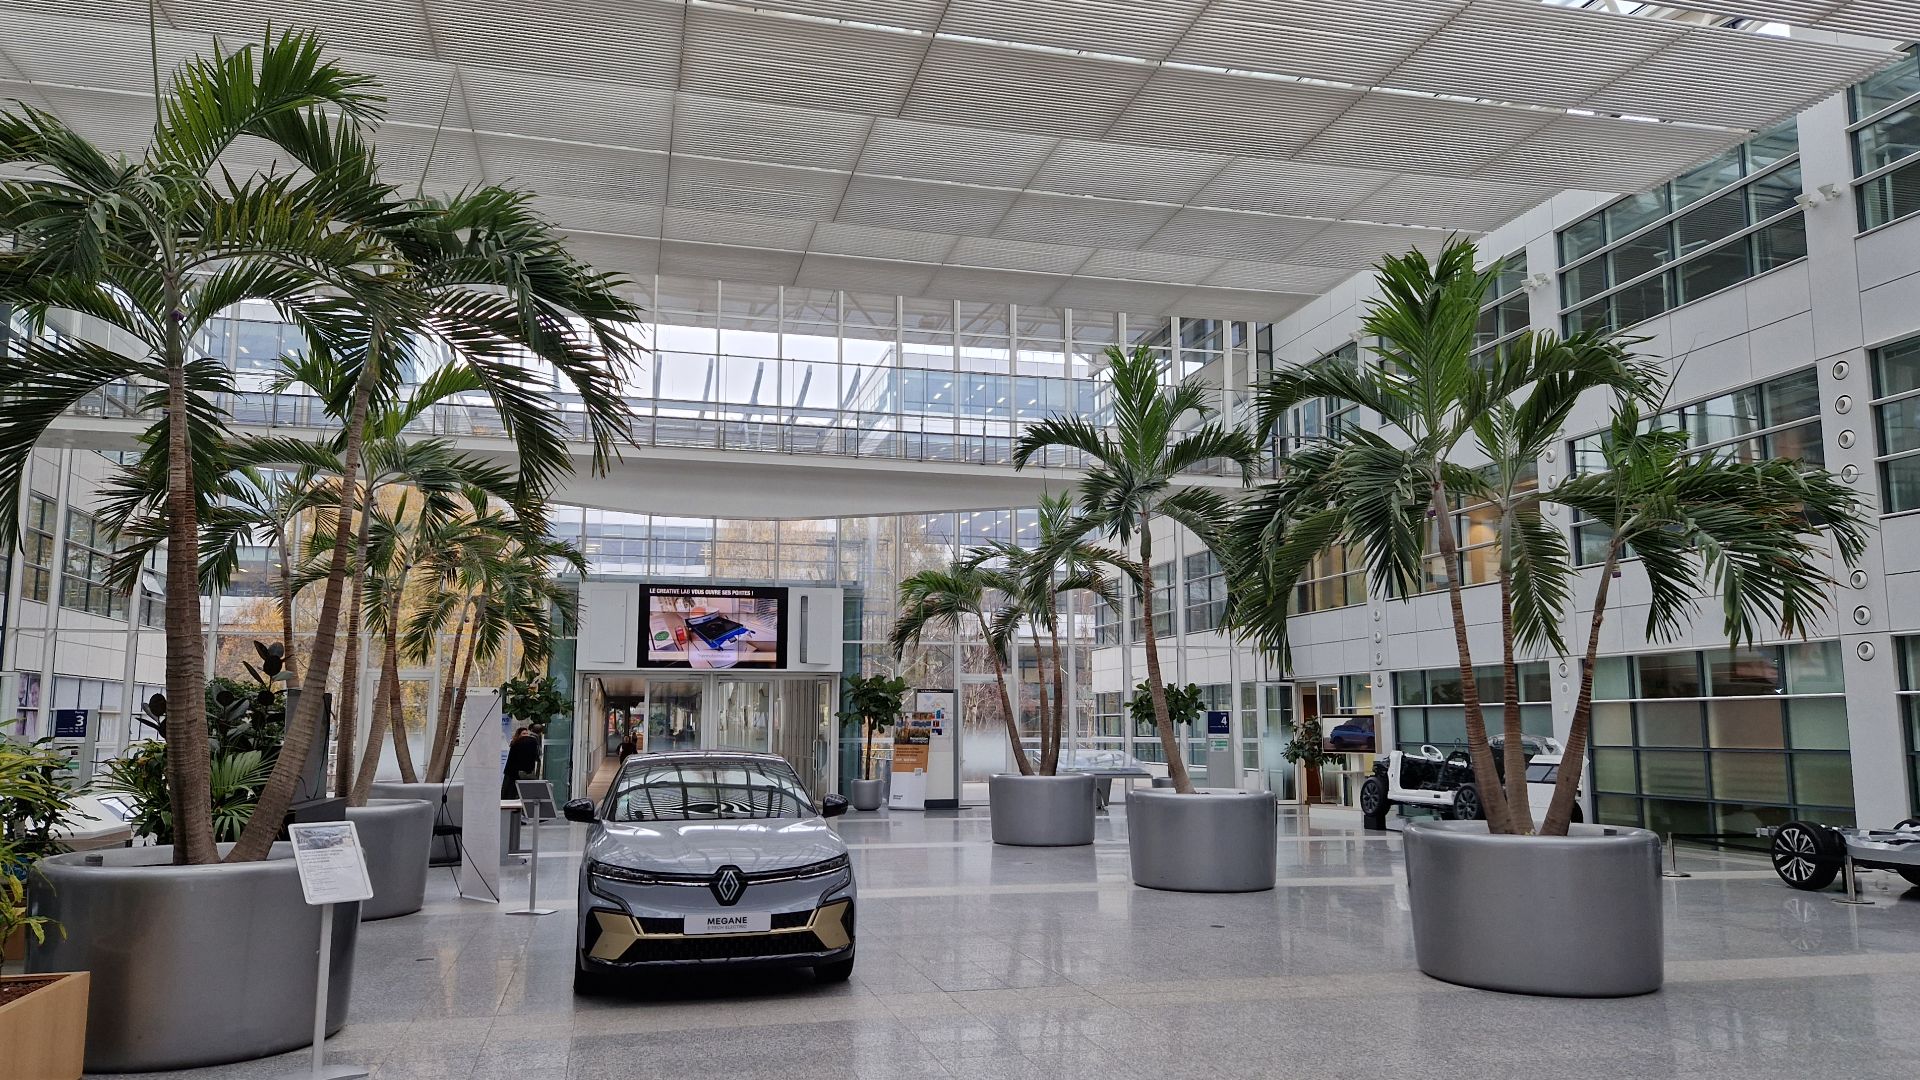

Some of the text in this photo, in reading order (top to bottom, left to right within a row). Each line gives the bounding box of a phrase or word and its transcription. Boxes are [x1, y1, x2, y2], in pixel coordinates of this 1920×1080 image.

[75, 715, 84, 726] 3
[1220, 716, 1227, 725] 4
[707, 916, 748, 925] MEGANE
